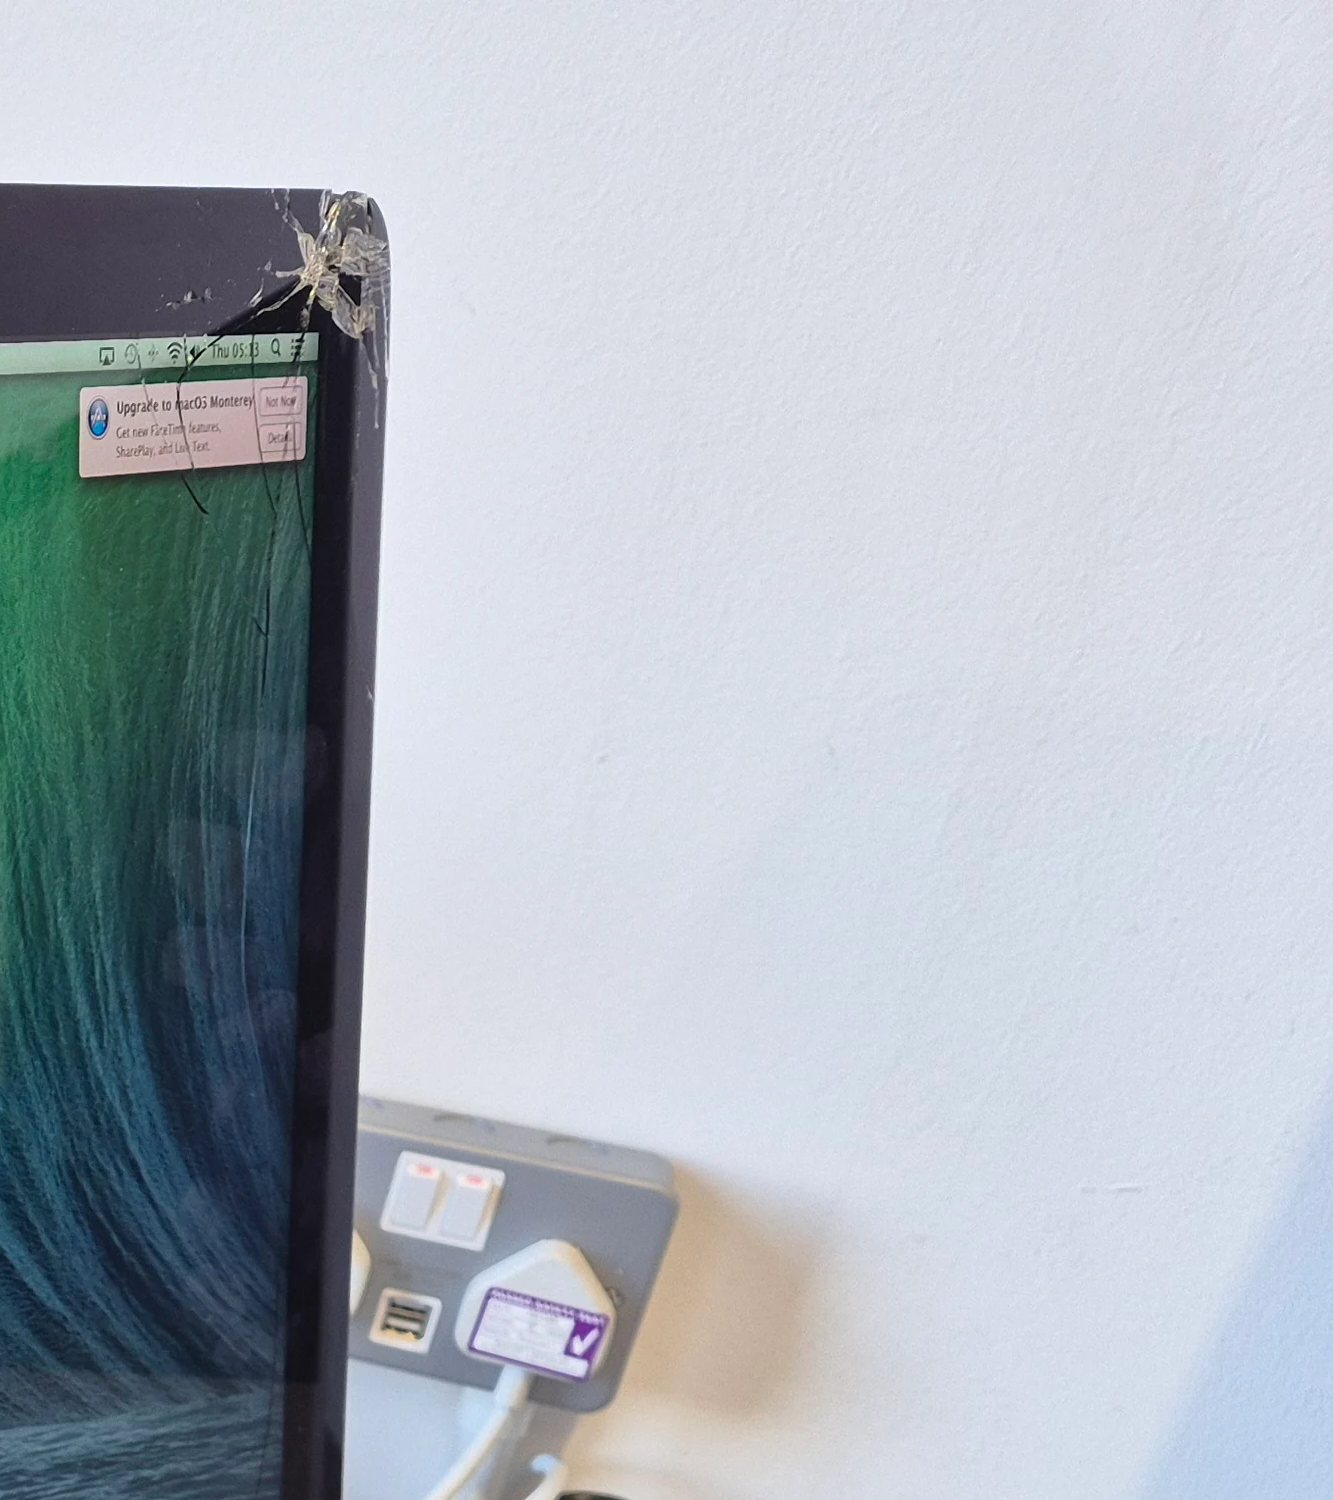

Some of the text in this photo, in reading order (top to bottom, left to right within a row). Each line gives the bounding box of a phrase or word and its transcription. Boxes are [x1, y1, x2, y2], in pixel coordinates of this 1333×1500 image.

[213, 342, 230, 358] Thu
[116, 397, 159, 418] Upgrade
[162, 399, 172, 412] to
[210, 394, 254, 411] Monterey
[133, 427, 149, 438] new
